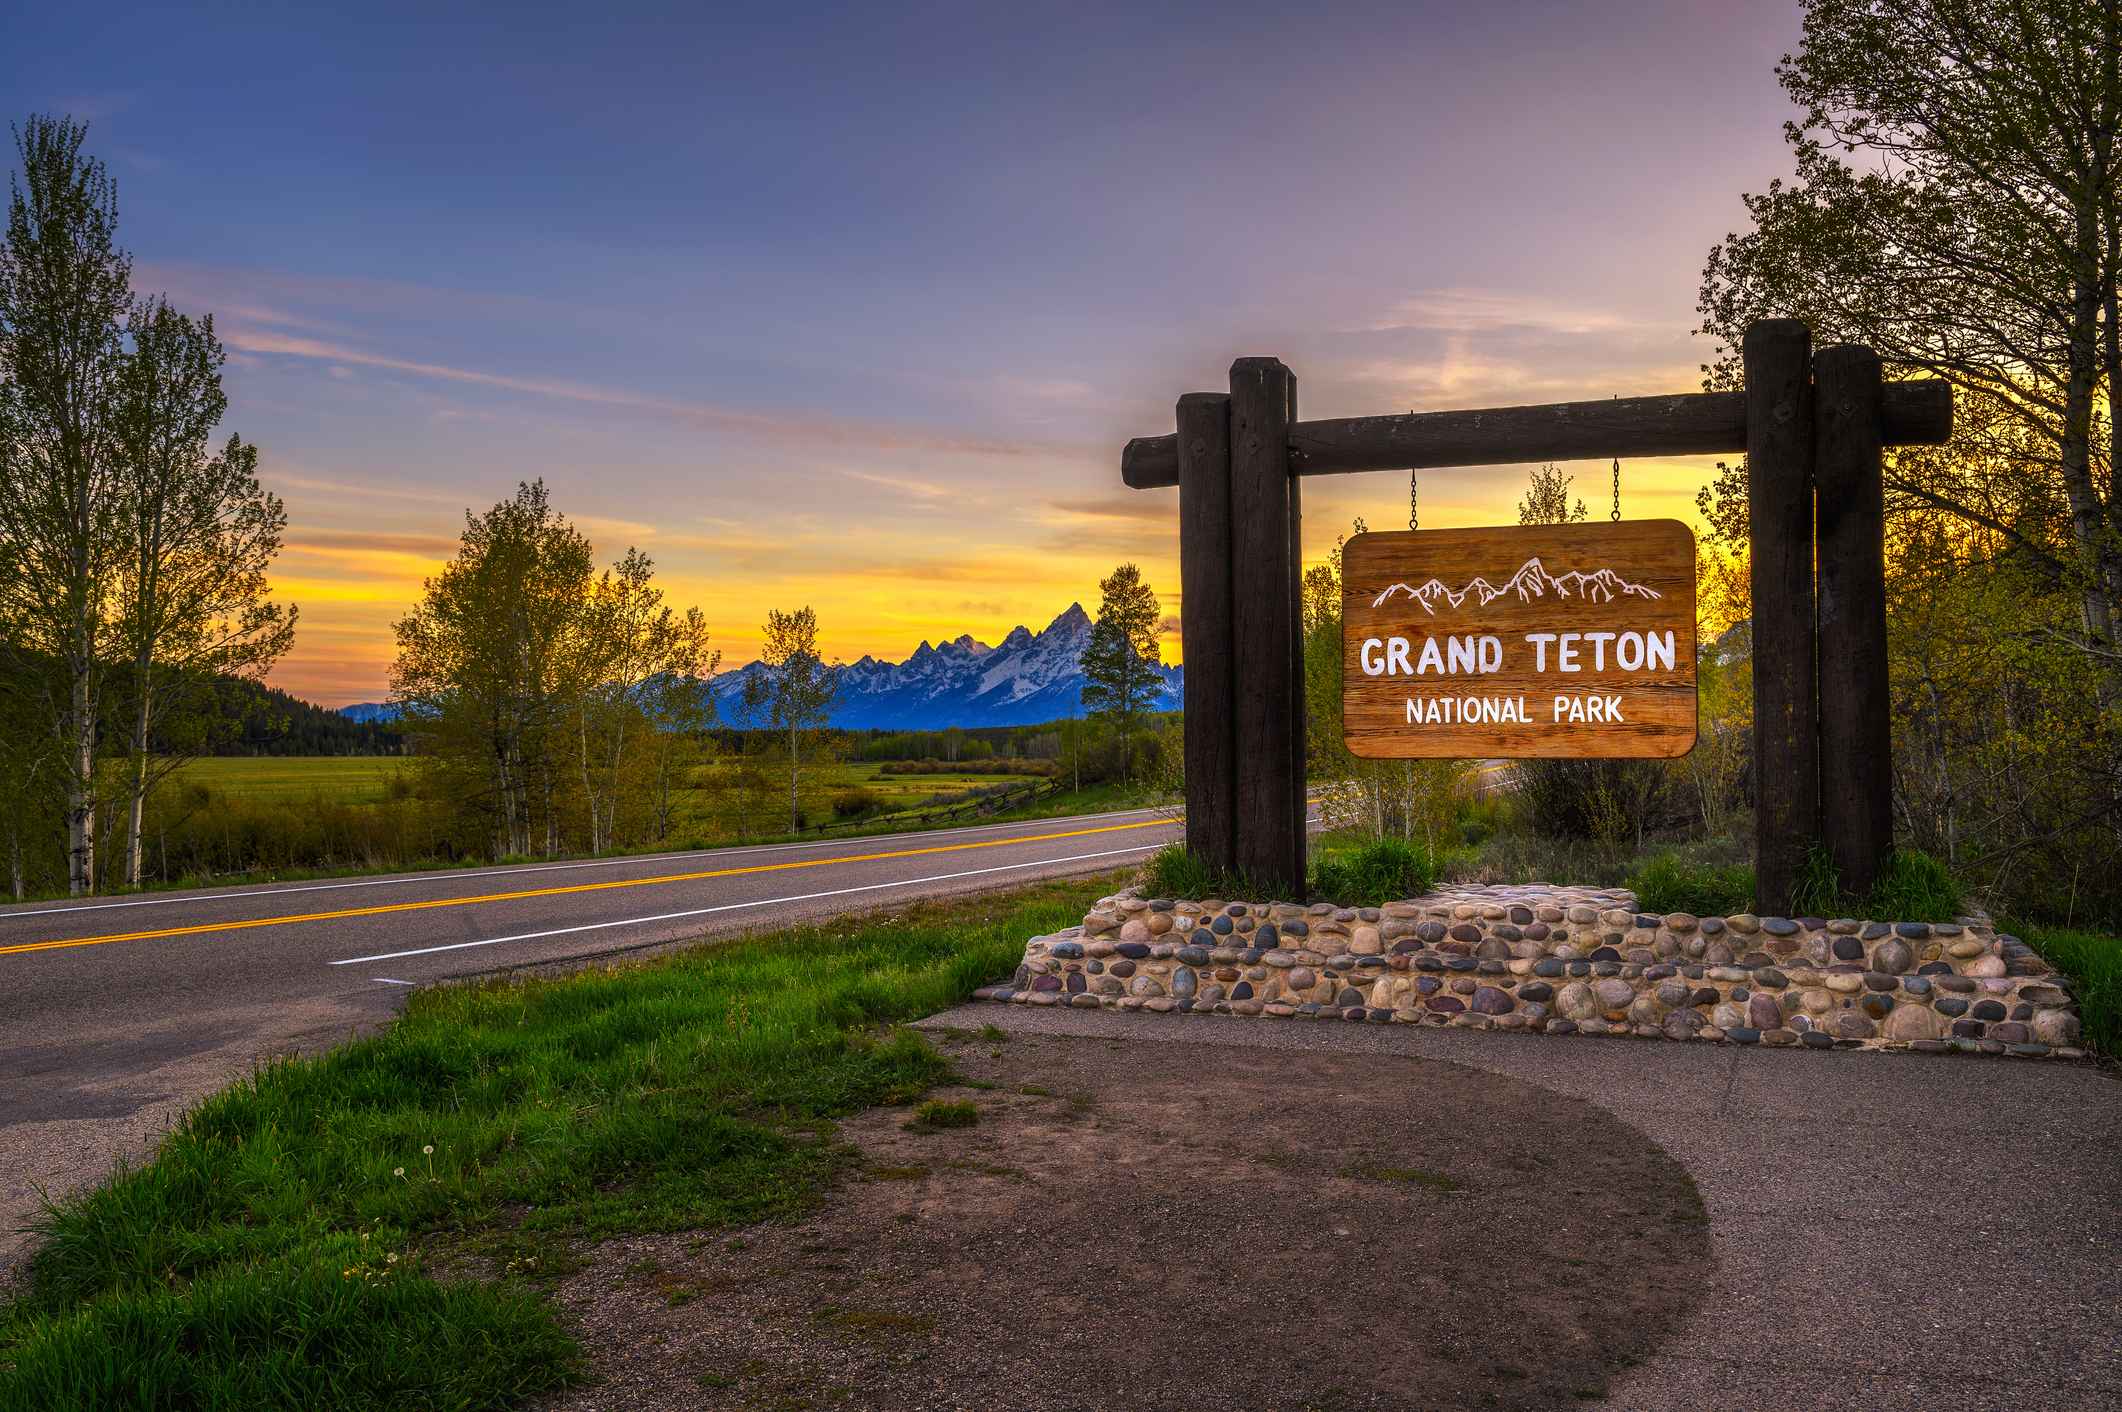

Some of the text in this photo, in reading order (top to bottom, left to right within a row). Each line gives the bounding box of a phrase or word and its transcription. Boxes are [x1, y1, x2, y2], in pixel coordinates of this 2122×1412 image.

[1360, 630, 1676, 676] GRAND TETON
[1406, 695, 1625, 724] NATIONAL PARK
